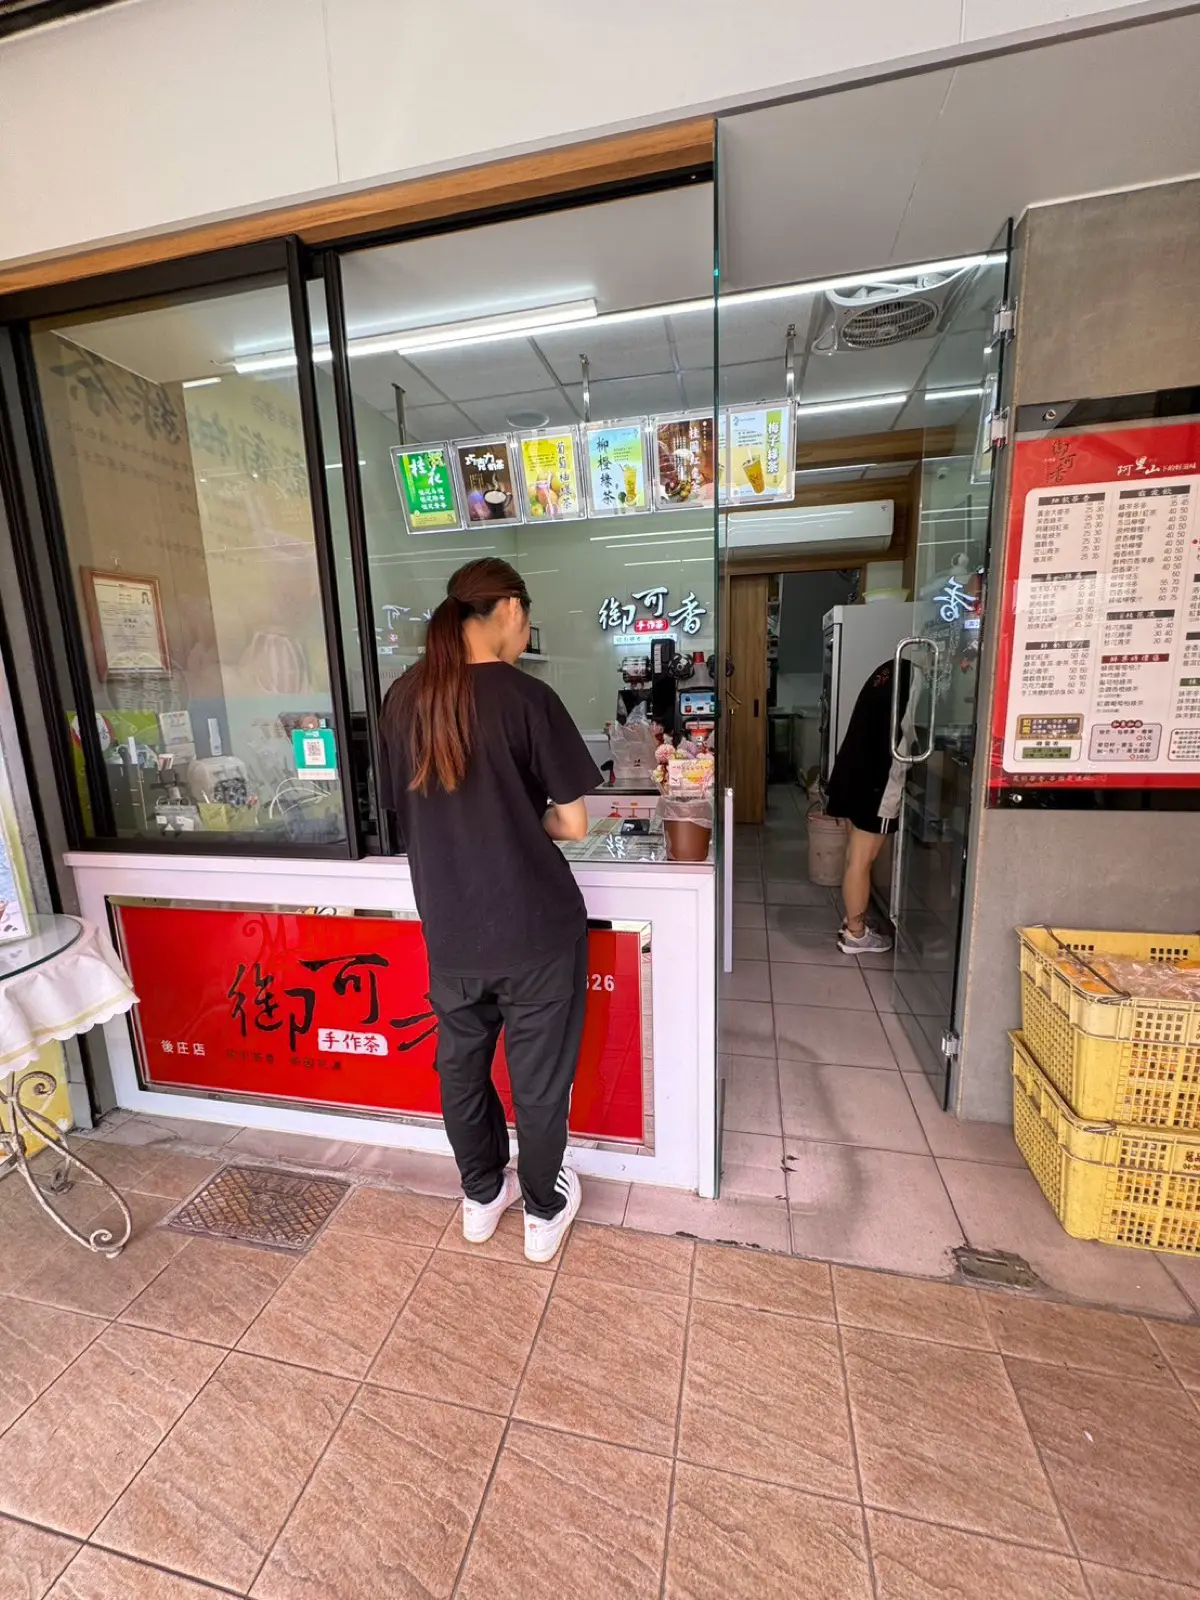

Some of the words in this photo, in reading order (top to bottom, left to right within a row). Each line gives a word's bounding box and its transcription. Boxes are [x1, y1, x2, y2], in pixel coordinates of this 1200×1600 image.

[408, 456, 443, 486] 桂花
[596, 436, 616, 505] 柳橙綠茶
[598, 587, 706, 635] 御可香
[227, 953, 438, 1052] 御可
[160, 1039, 206, 1057] 後庄店
[321, 1032, 380, 1053] 手作茶
